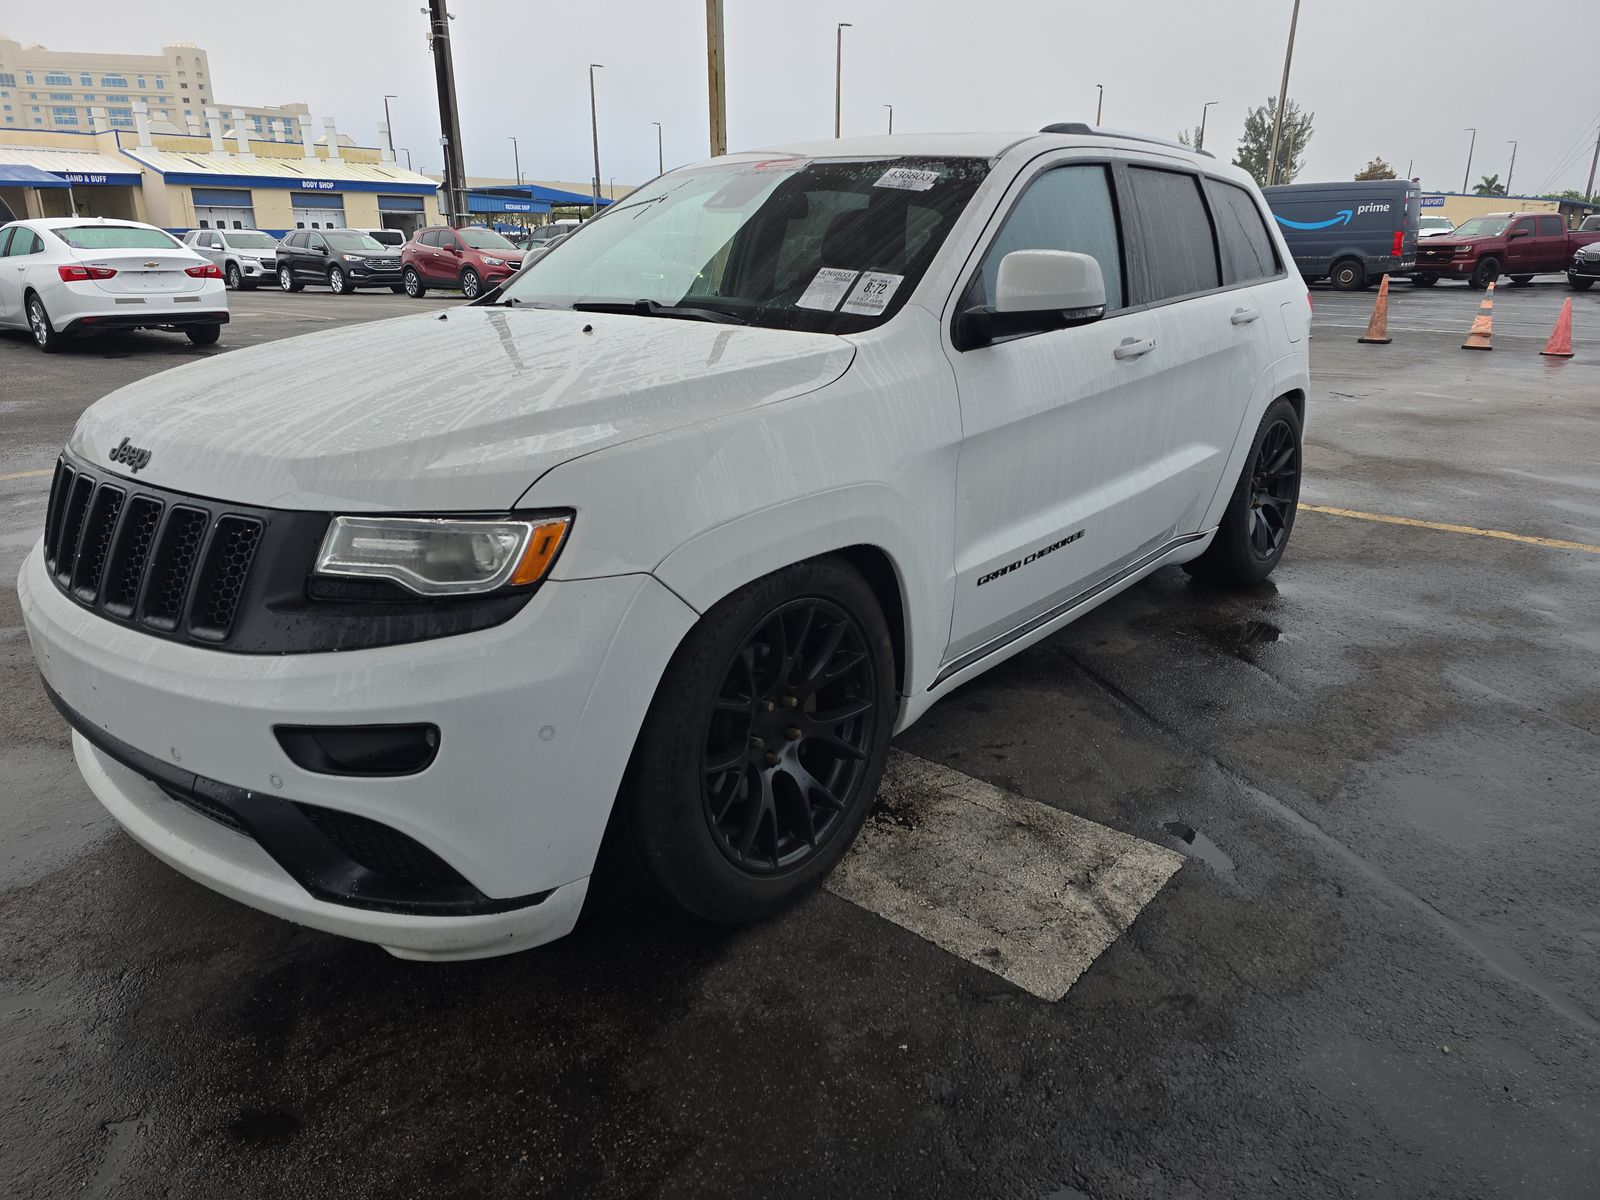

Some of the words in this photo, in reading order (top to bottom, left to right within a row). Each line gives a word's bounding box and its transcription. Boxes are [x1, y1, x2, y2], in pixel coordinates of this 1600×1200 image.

[65, 174, 83, 183] SAND
[84, 175, 90, 183] &
[90, 175, 107, 183] BUFF
[302, 180, 318, 188] BODY
[318, 181, 334, 189] SHOP
[1357, 202, 1390, 215] prime
[863, 282, 887, 295] 8:72
[109, 437, 151, 474] Jeep
[977, 560, 1022, 586] GRAND
[1023, 529, 1085, 565] CHEROKEE
